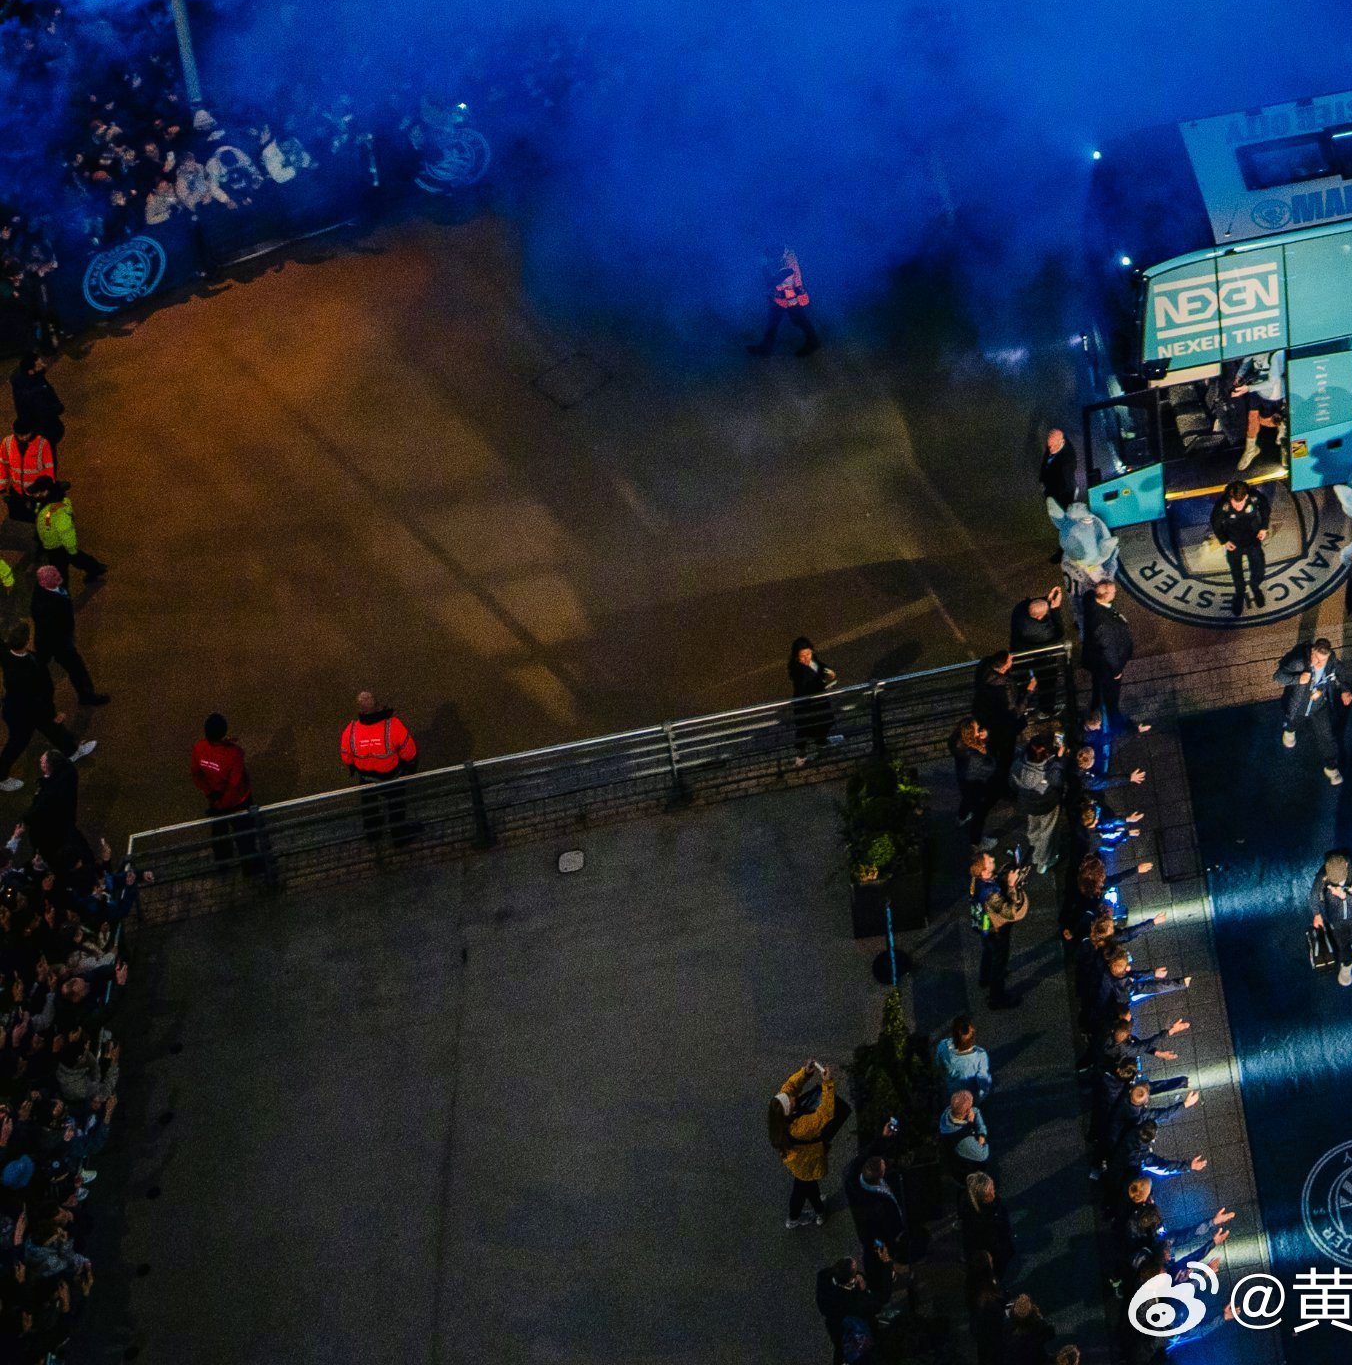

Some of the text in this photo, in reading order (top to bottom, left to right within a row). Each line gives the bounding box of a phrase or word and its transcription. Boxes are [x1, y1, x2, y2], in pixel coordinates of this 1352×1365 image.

[1154, 273, 1280, 328] NEXEN
[1157, 322, 1281, 359] NEXEN TIRE
